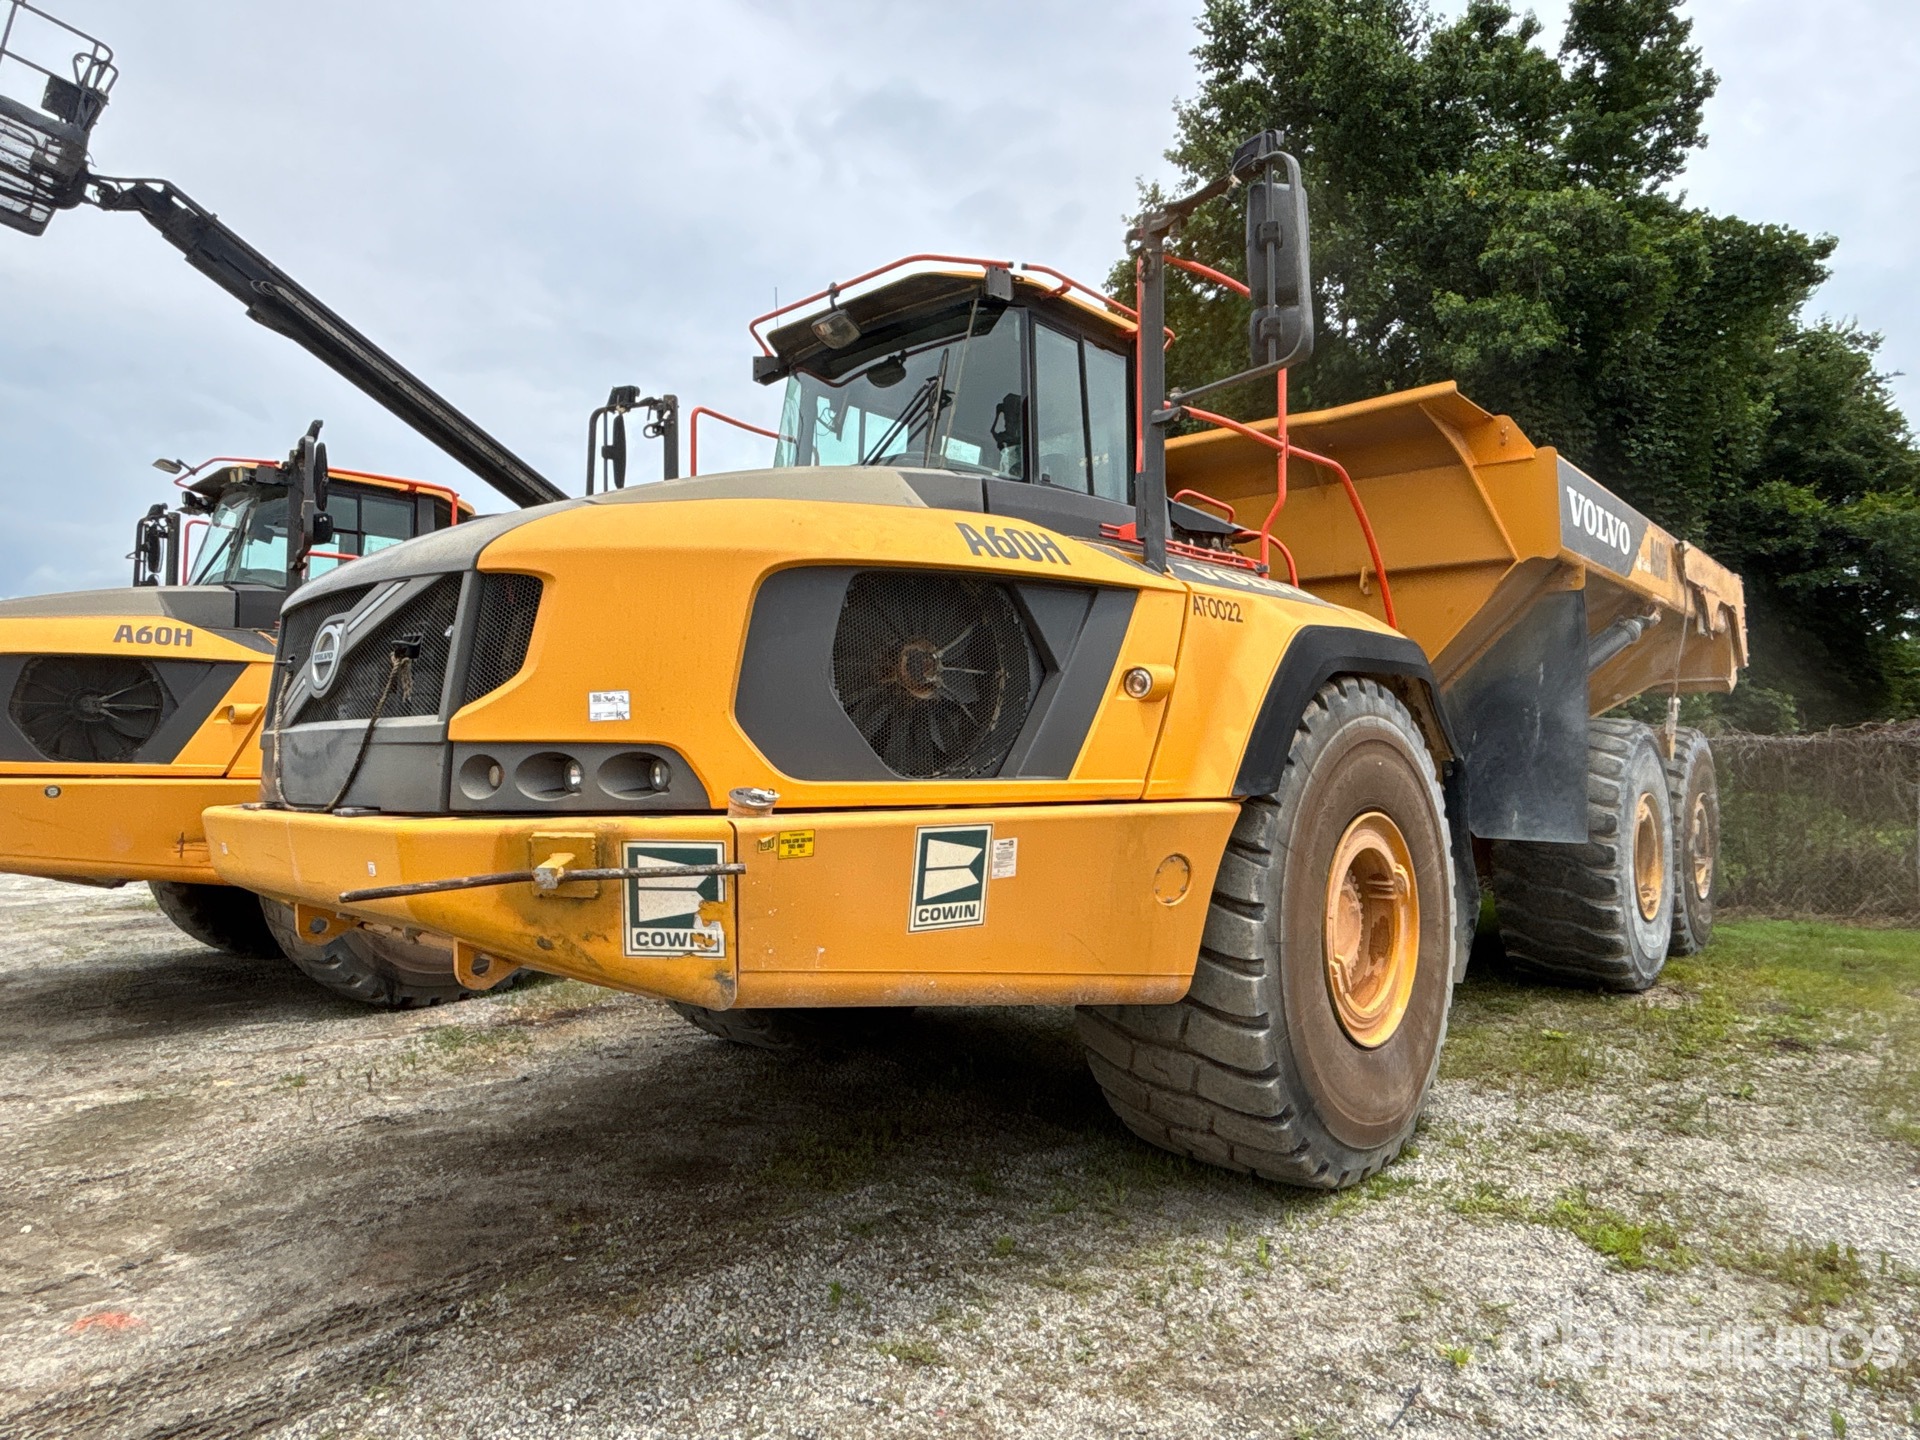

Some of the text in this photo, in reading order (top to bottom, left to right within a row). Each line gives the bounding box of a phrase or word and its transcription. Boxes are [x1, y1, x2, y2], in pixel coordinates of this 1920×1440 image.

[1566, 485, 1631, 555] VOLVO
[954, 522, 1071, 565] A60H
[113, 624, 193, 647] A60H
[918, 904, 976, 922] COWIN
